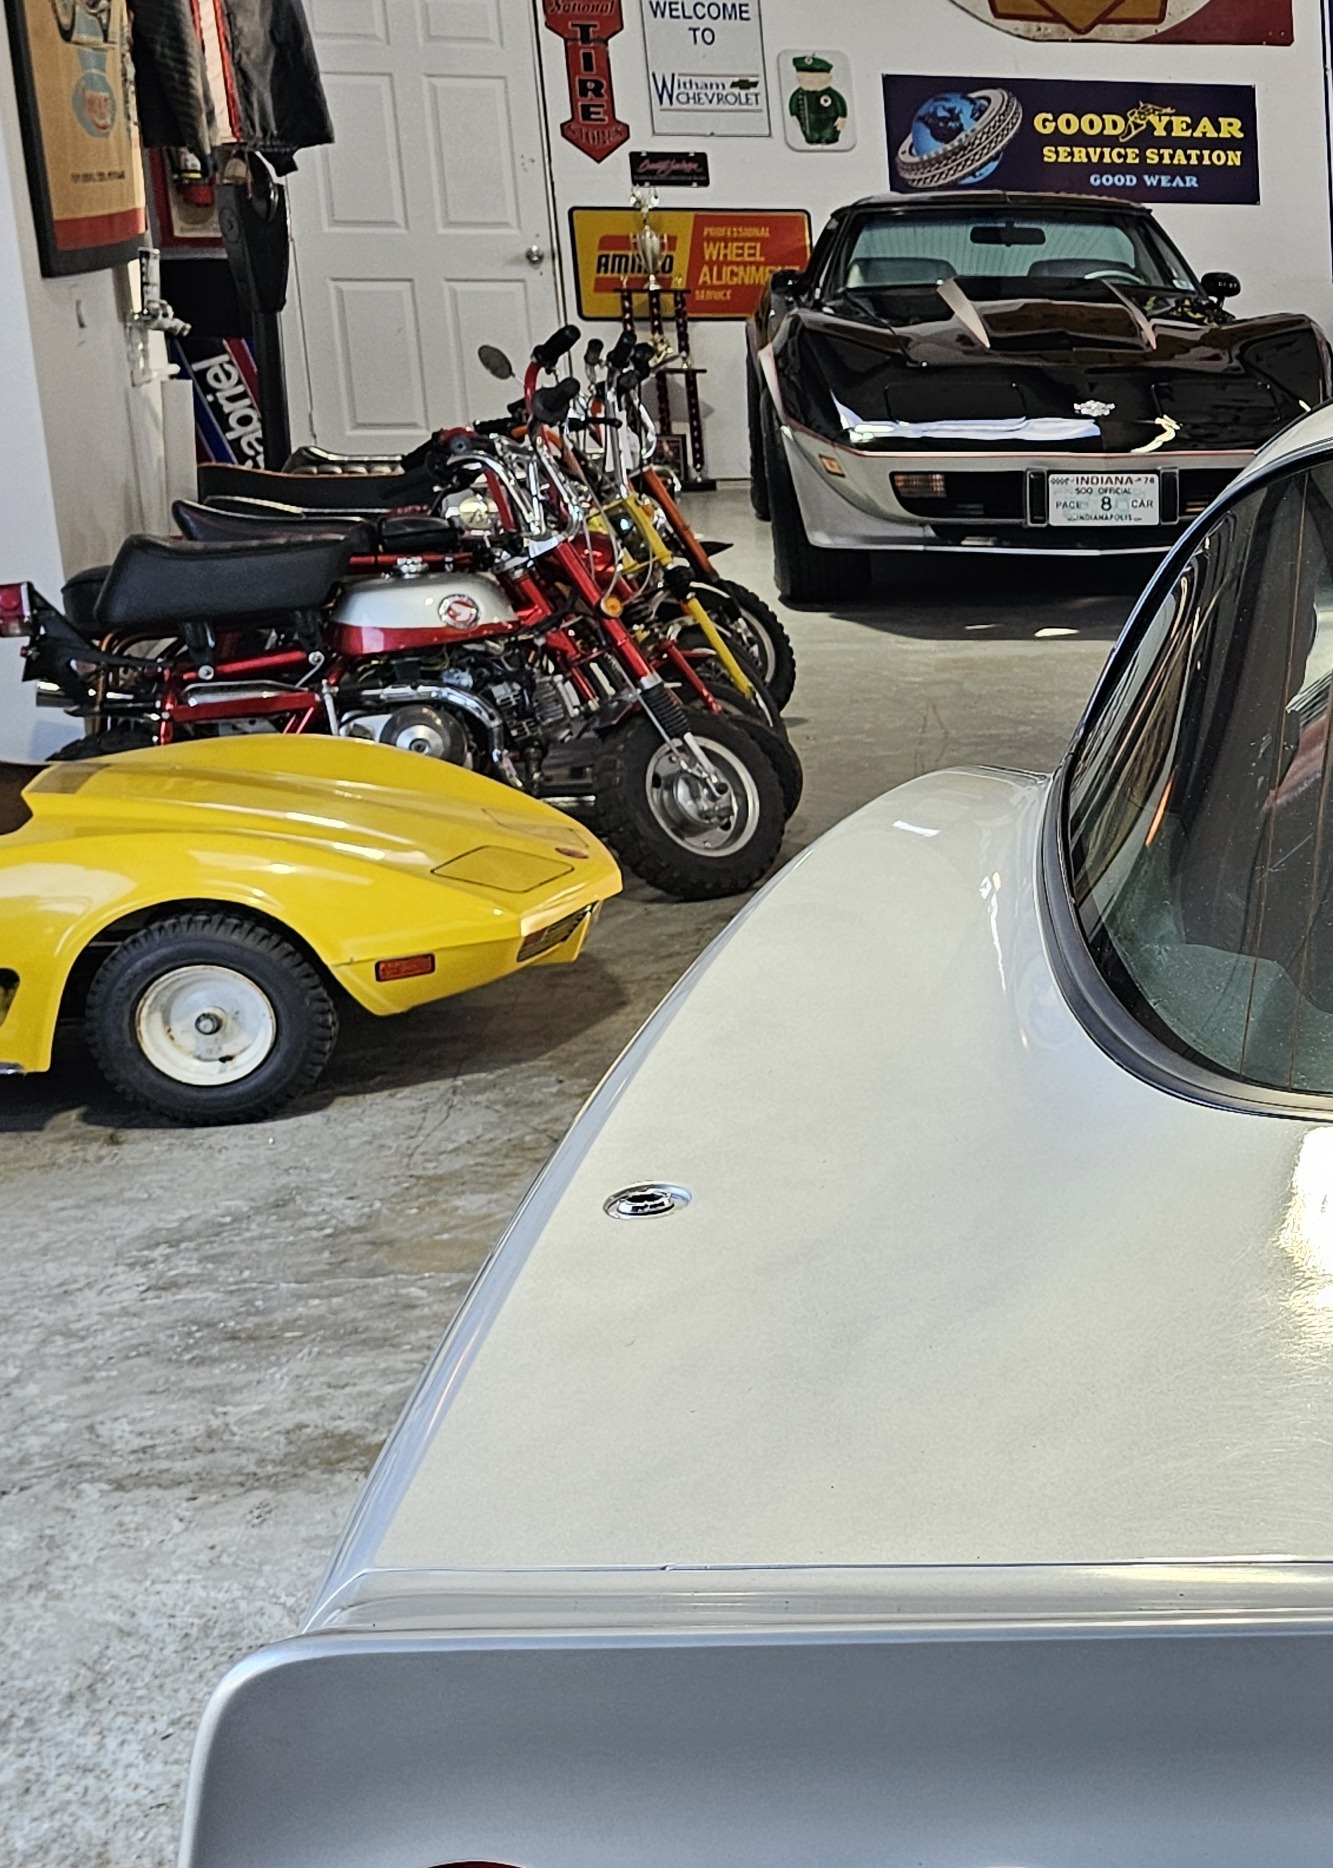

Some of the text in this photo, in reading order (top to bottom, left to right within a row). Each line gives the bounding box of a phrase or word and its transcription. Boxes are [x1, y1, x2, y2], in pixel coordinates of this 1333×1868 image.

[650, 1, 751, 21] WELCOME
[688, 27, 715, 45] TO
[568, 21, 609, 124] TIRE
[652, 71, 726, 106] Witham
[676, 92, 761, 106] CHEVROLET
[1043, 146, 1242, 166] SERVICE STATION
[1089, 174, 1198, 188] GOOD WEAR
[703, 241, 765, 262] WHEEL
[1075, 475, 1134, 486] INDIANA
[1101, 496, 1112, 511] 8
[1131, 499, 1153, 508] CAR
